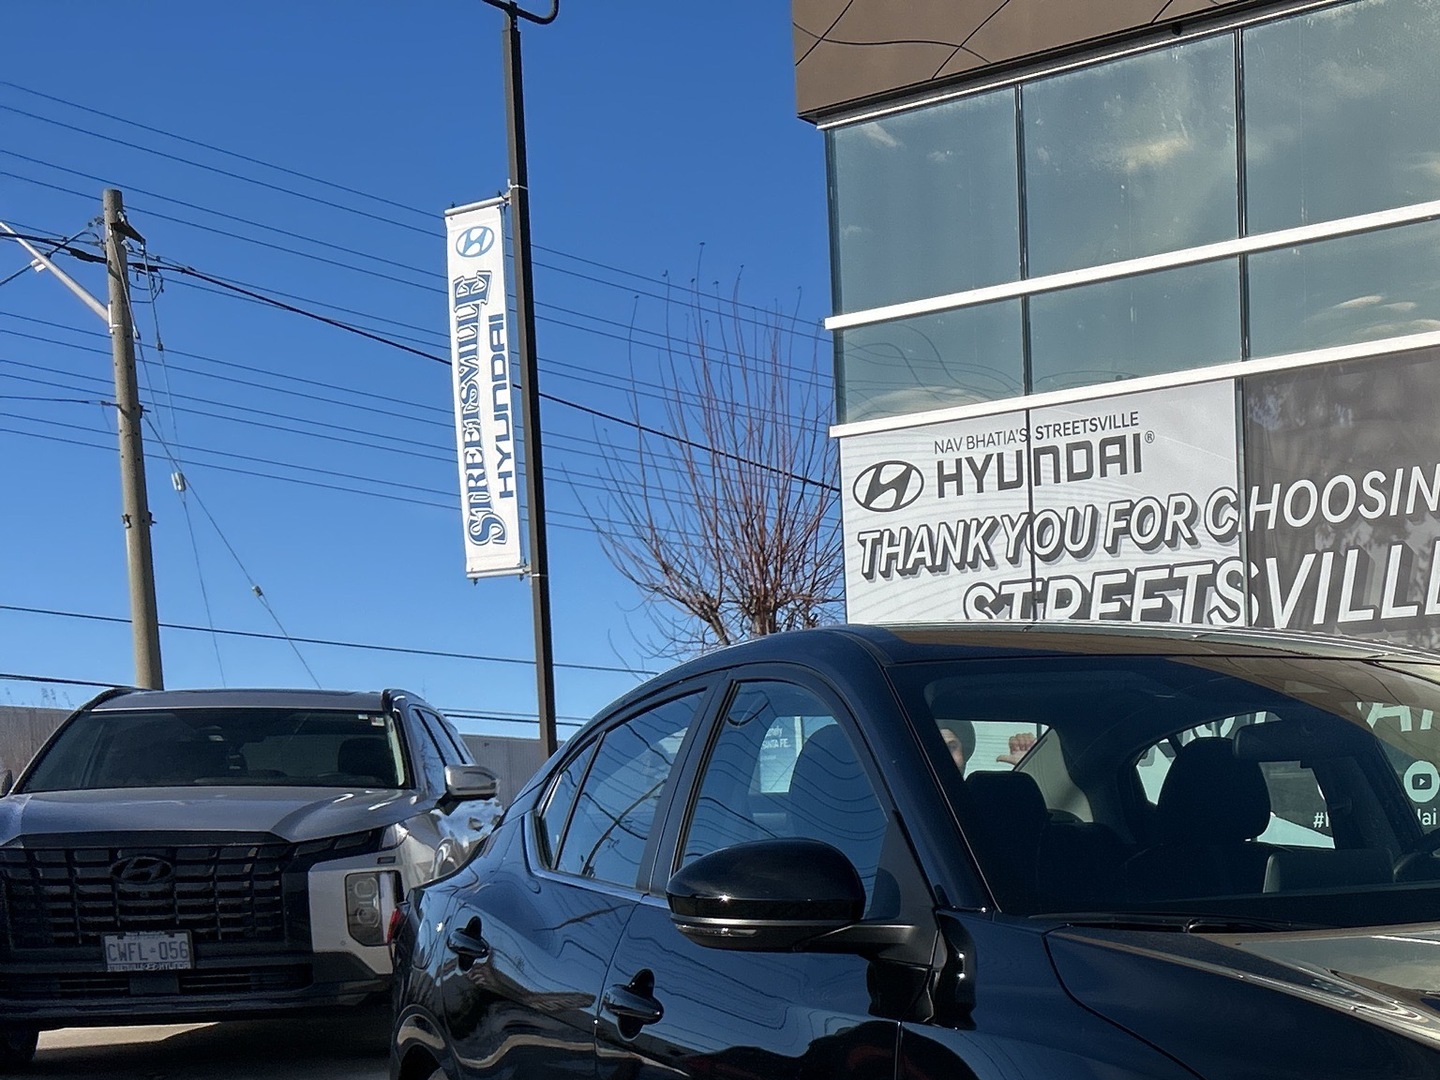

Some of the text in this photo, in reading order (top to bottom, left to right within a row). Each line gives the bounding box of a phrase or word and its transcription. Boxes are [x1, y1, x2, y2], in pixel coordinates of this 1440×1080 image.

[453, 269, 508, 545] STREETSVILLE
[488, 313, 514, 499] HYUNDAI
[934, 411, 1139, 454] NAV BHATIA'S STREETSVILLE
[858, 517, 999, 580] THANK
[1000, 504, 1097, 565] YOU
[1104, 492, 1202, 556] FOR
